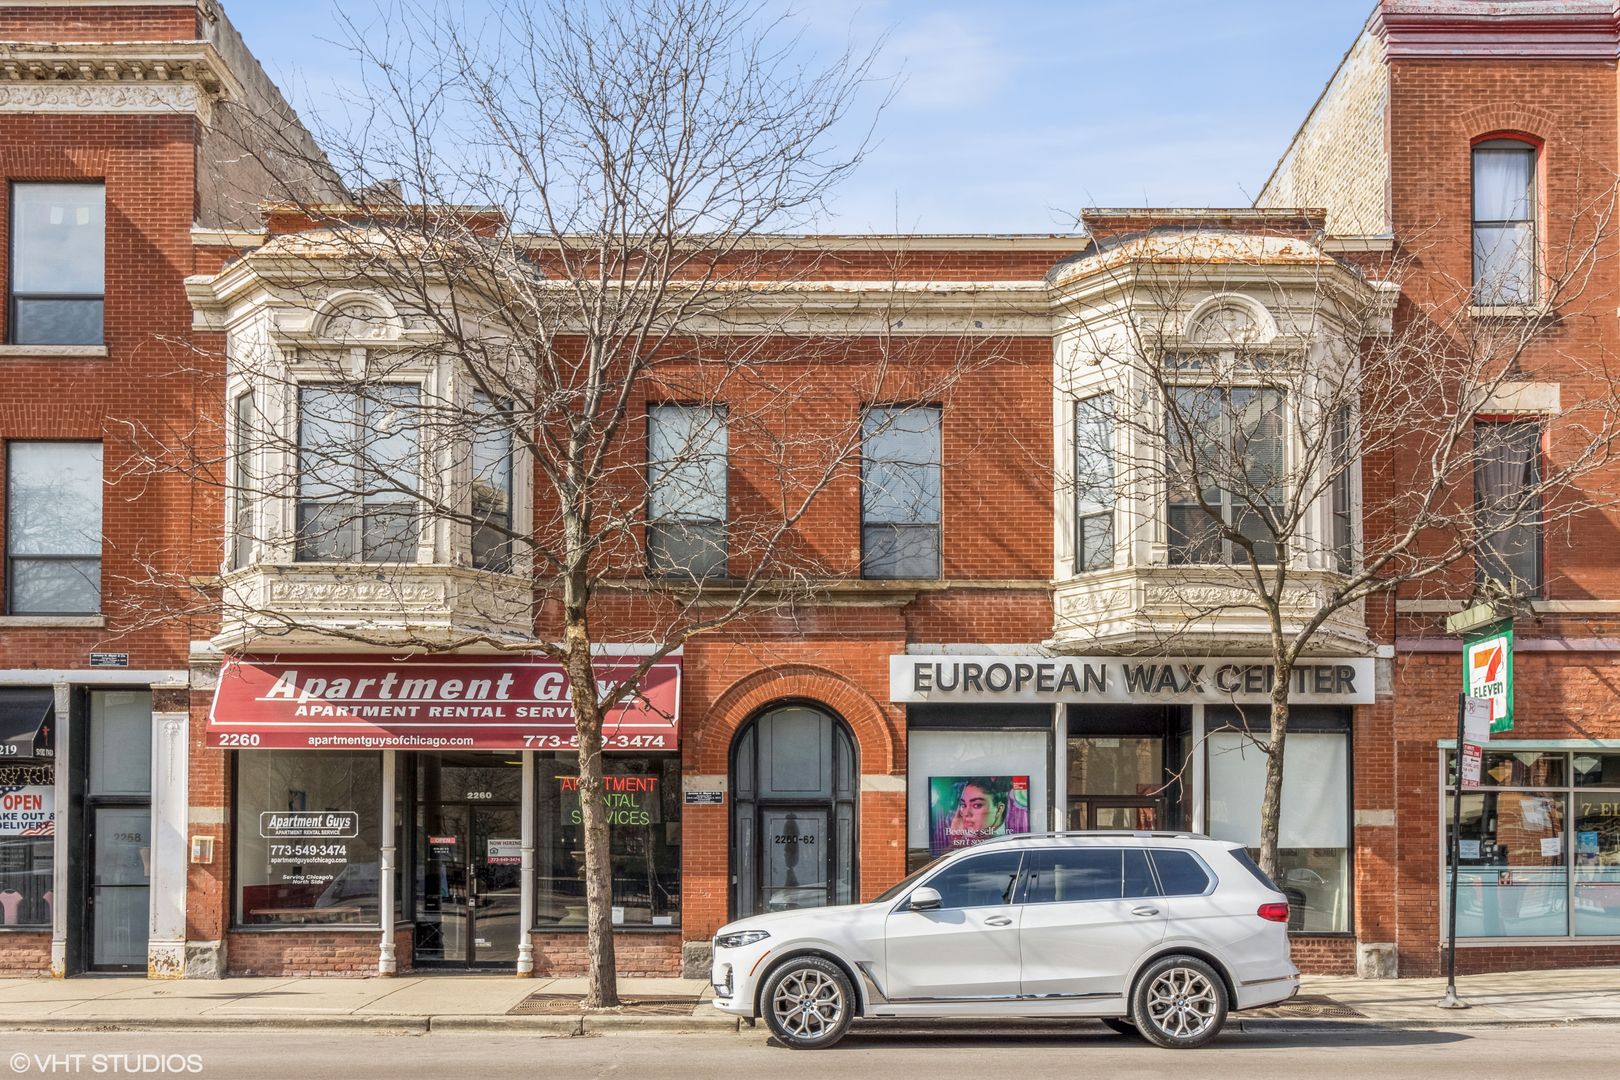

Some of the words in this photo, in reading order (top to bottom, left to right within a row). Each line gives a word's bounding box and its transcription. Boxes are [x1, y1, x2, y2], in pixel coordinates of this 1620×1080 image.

[914, 662, 1107, 693] EUROPEAN
[1122, 663, 1205, 693] WAX
[265, 670, 515, 704] Apartment
[294, 705, 420, 717] APARTMENT
[428, 706, 506, 718] RENTAL
[219, 733, 260, 746] 2260
[308, 735, 474, 748] apartmentguysofchicago.com
[522, 735, 665, 748] 773-59-3474
[466, 791, 492, 799] 2260
[3, 795, 42, 811] OPEN
[21, 812, 45, 820] OUT
[48, 812, 55, 820] &
[269, 814, 323, 829] Apartment
[325, 814, 351, 830] Guys
[113, 832, 142, 842] 2258
[945, 827, 979, 836] Because
[775, 835, 815, 844] 2260-62
